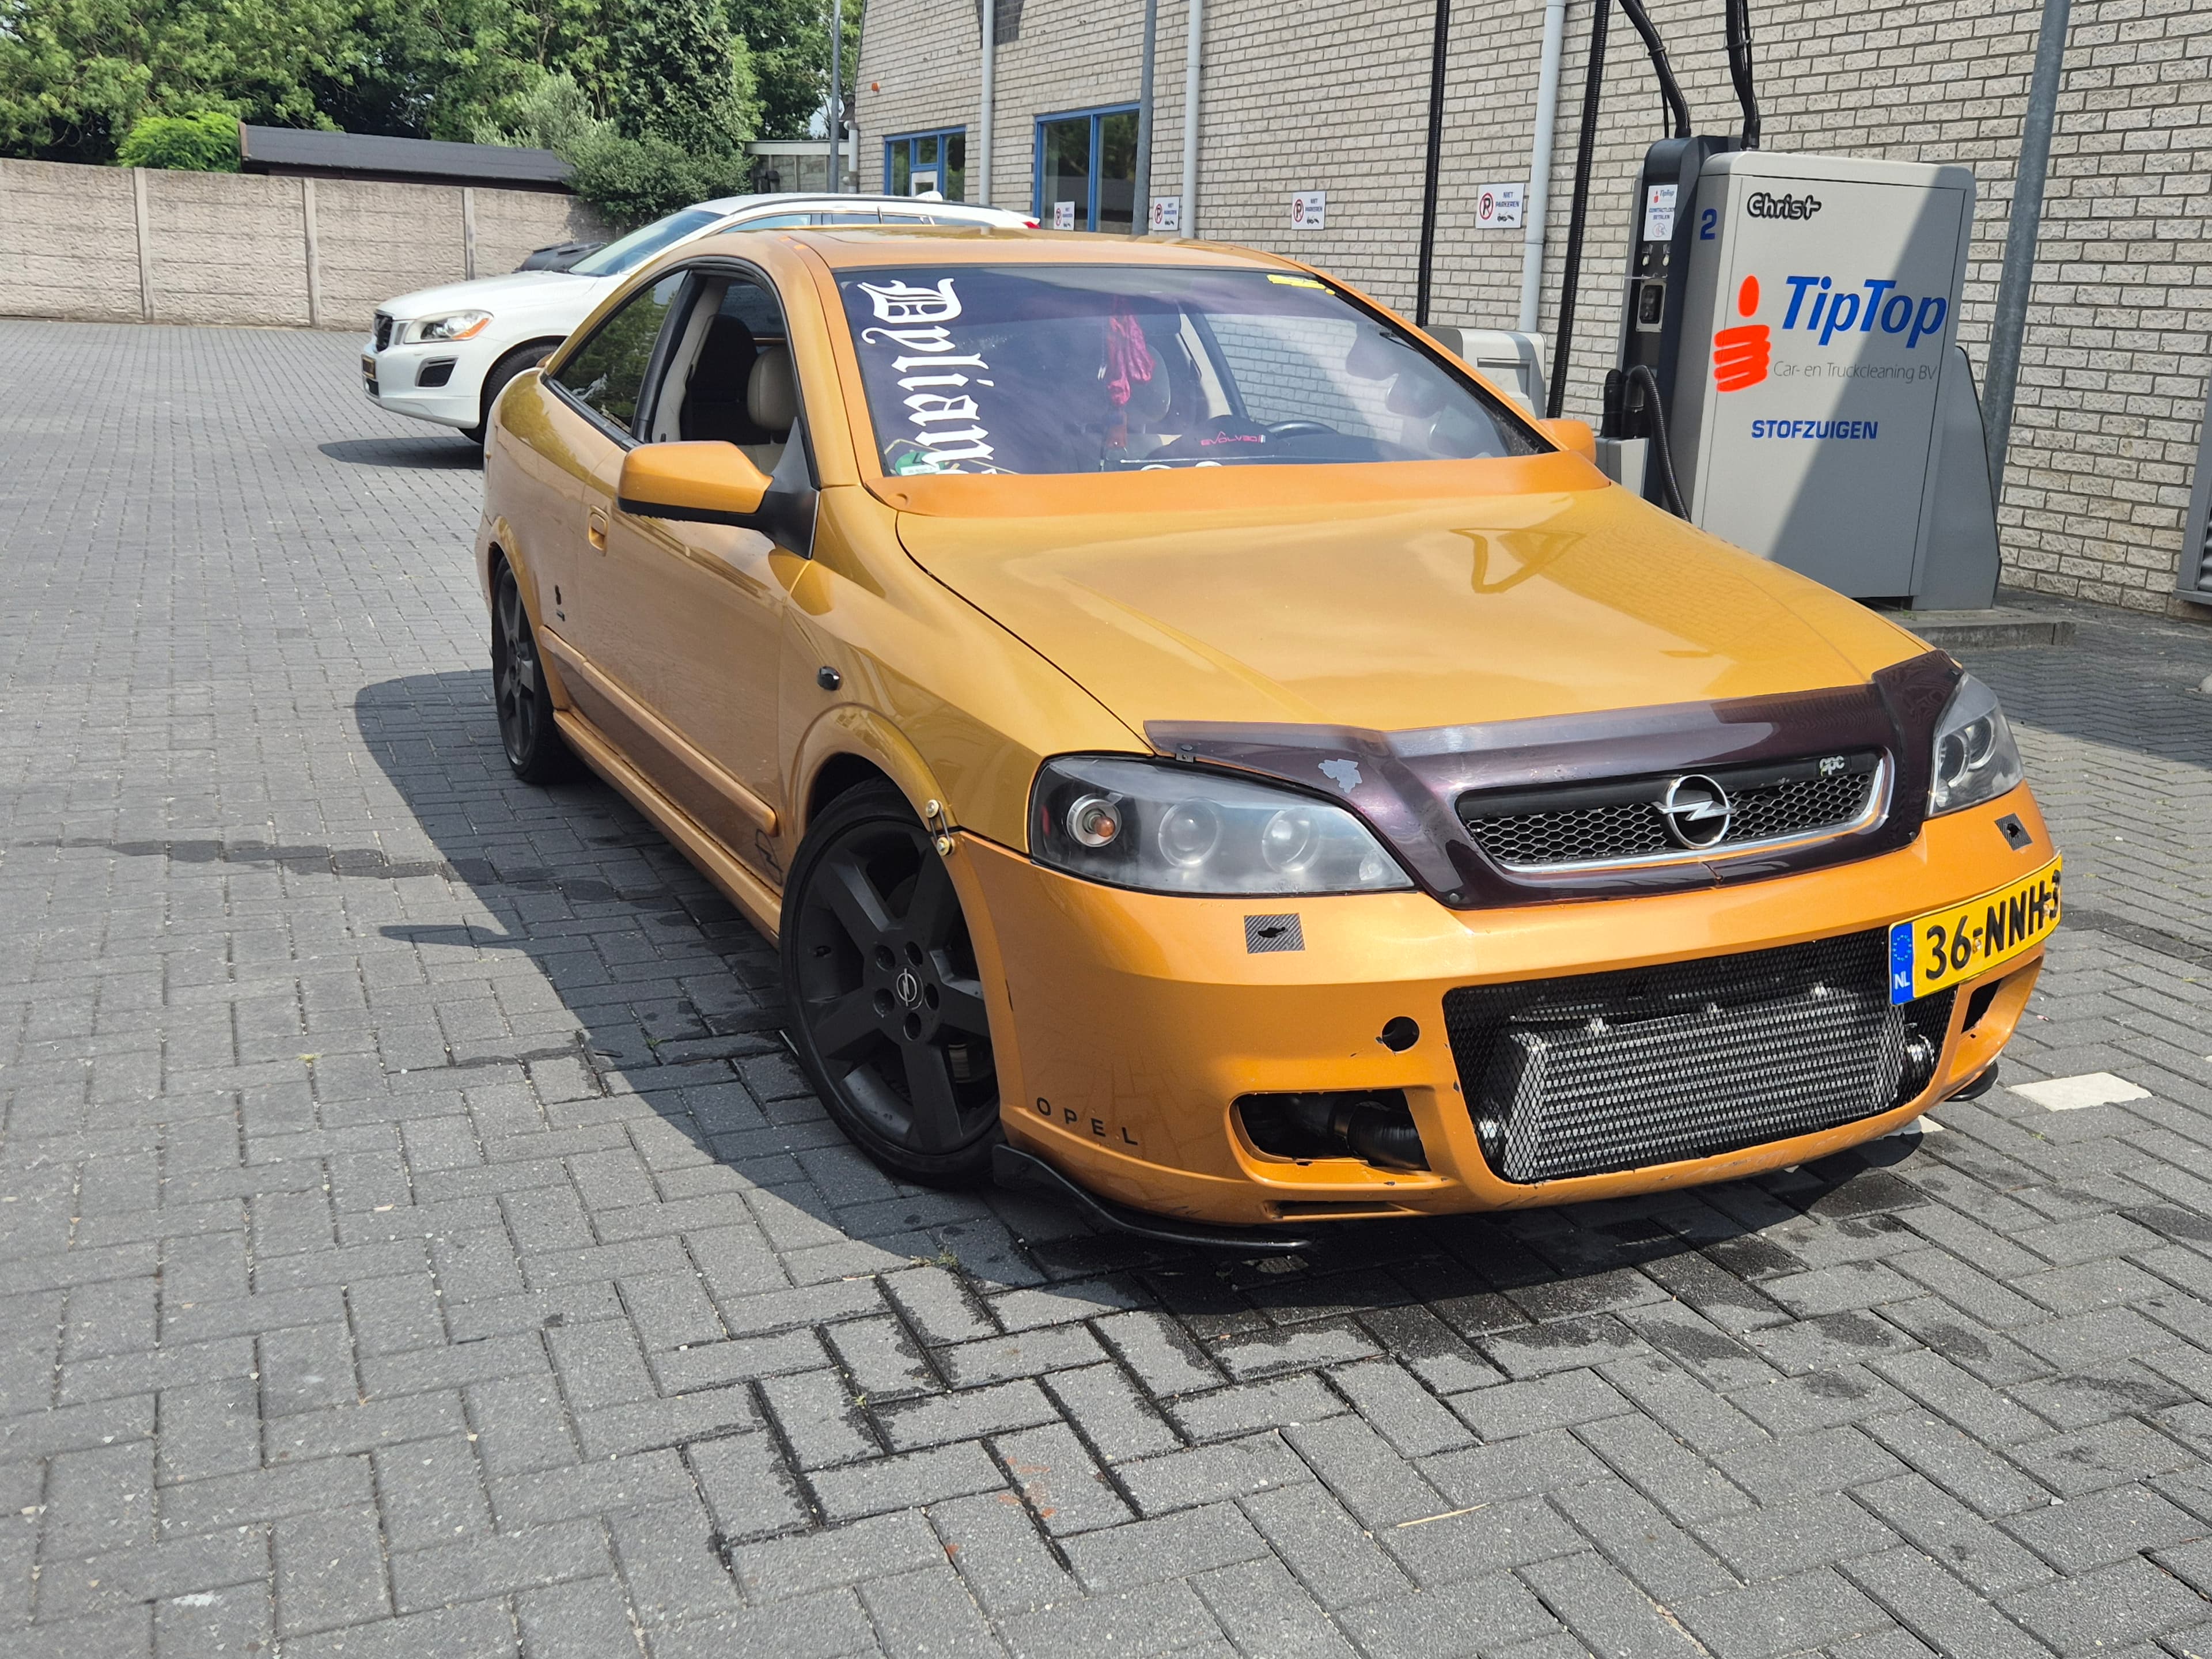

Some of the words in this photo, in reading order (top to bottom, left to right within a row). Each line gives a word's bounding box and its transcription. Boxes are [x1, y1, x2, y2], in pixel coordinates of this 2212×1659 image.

[1747, 192, 1821, 220] Christ
[1700, 209, 1717, 240] 2
[1782, 275, 1946, 349] TipTop
[857, 278, 998, 474] Dylian
[1774, 361, 1800, 377] Car-
[1804, 365, 1821, 377] en
[1827, 362, 1914, 384] Truckcleaning
[1919, 365, 1938, 380] BV
[1751, 420, 1878, 440] STOFZUIGEN
[1926, 869, 2061, 980] 36-NNH-3
[1895, 971, 1911, 990] NL
[1037, 1097, 1138, 1146] OPEL
